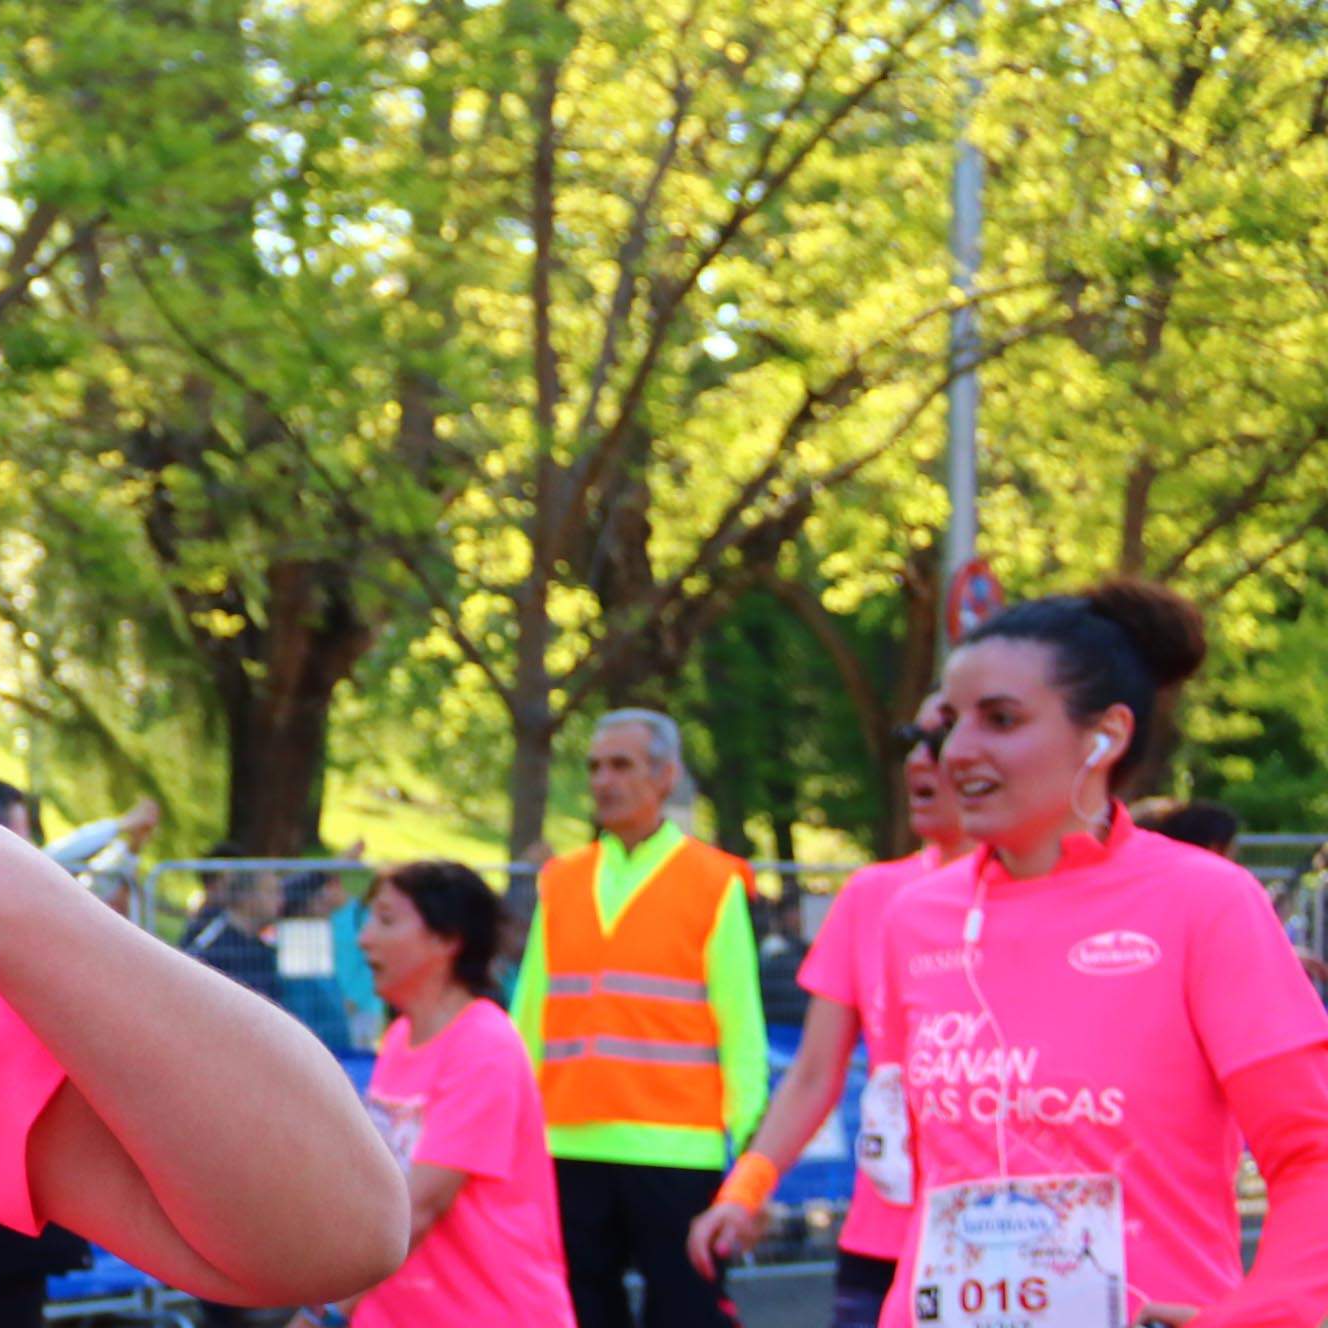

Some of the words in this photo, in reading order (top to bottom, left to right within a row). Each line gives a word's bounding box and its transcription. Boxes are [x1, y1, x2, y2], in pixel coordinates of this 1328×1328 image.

[912, 1012, 991, 1048] HOY
[917, 1087, 962, 1123] AS
[969, 1086, 1126, 1125] CHICAS
[960, 1276, 1050, 1314] 016
